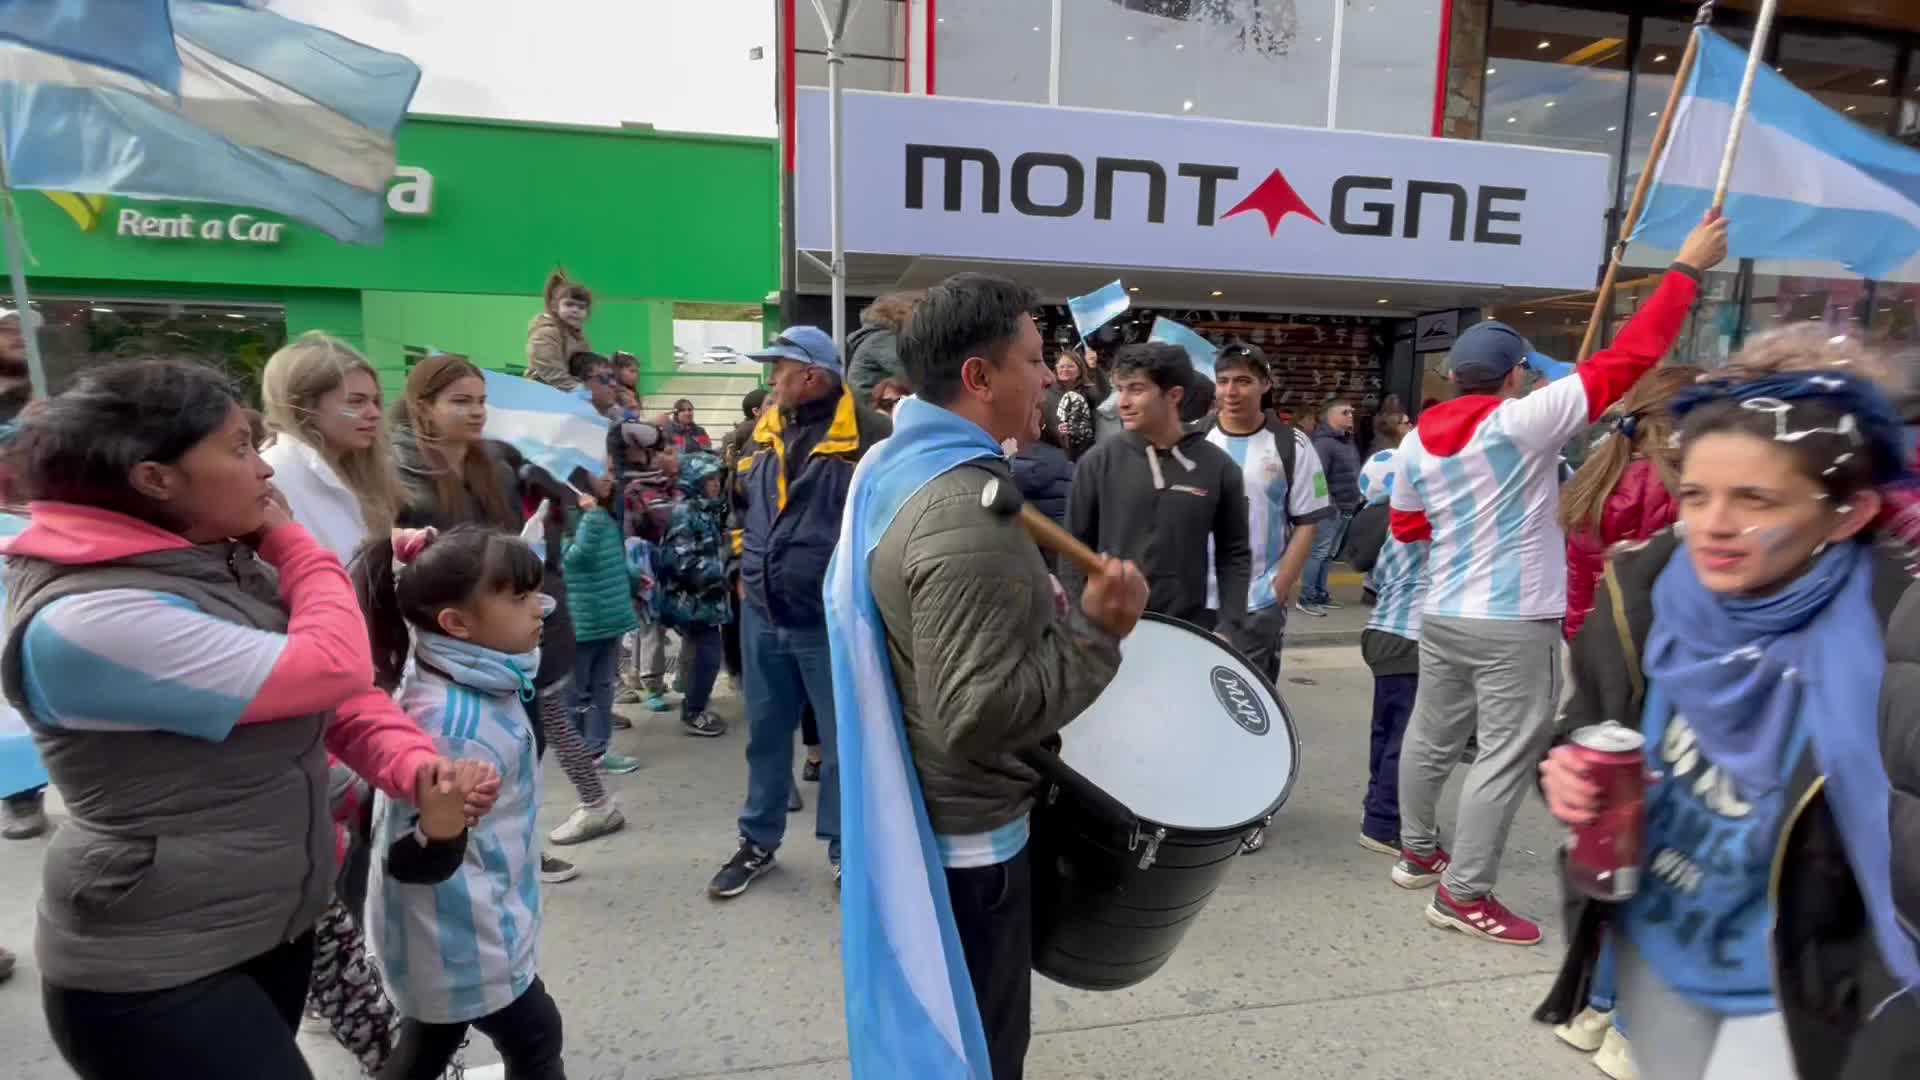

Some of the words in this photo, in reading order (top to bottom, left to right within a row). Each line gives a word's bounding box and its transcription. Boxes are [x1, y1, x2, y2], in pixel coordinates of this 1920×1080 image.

[904, 143, 1527, 246] MONTAGNE
[117, 208, 194, 238] Rent
[201, 219, 224, 240] a
[228, 213, 284, 242] Car
[1216, 676, 1262, 725] MXP
